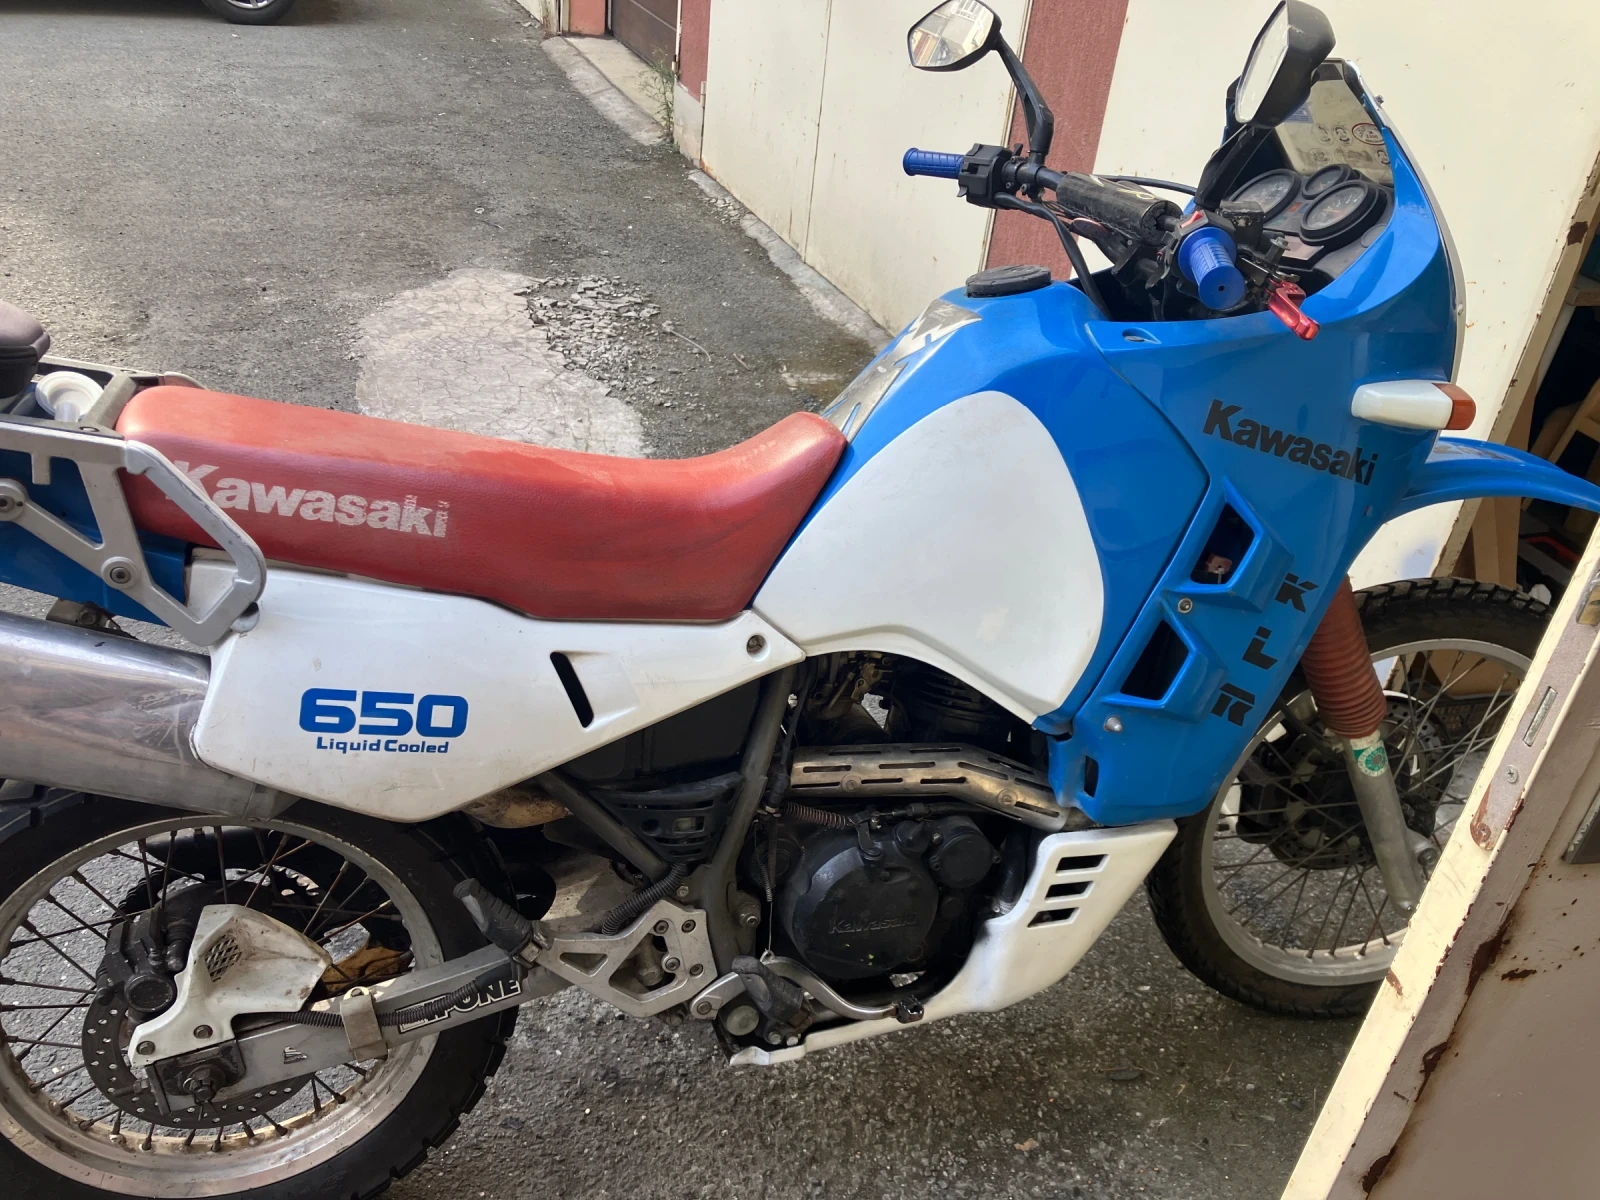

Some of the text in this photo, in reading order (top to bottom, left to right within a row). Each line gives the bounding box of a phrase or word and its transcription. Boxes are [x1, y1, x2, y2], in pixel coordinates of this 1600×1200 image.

[1203, 399, 1379, 486] Kawasaki
[299, 688, 469, 738] 650
[316, 737, 449, 754] Liquid Cooled
